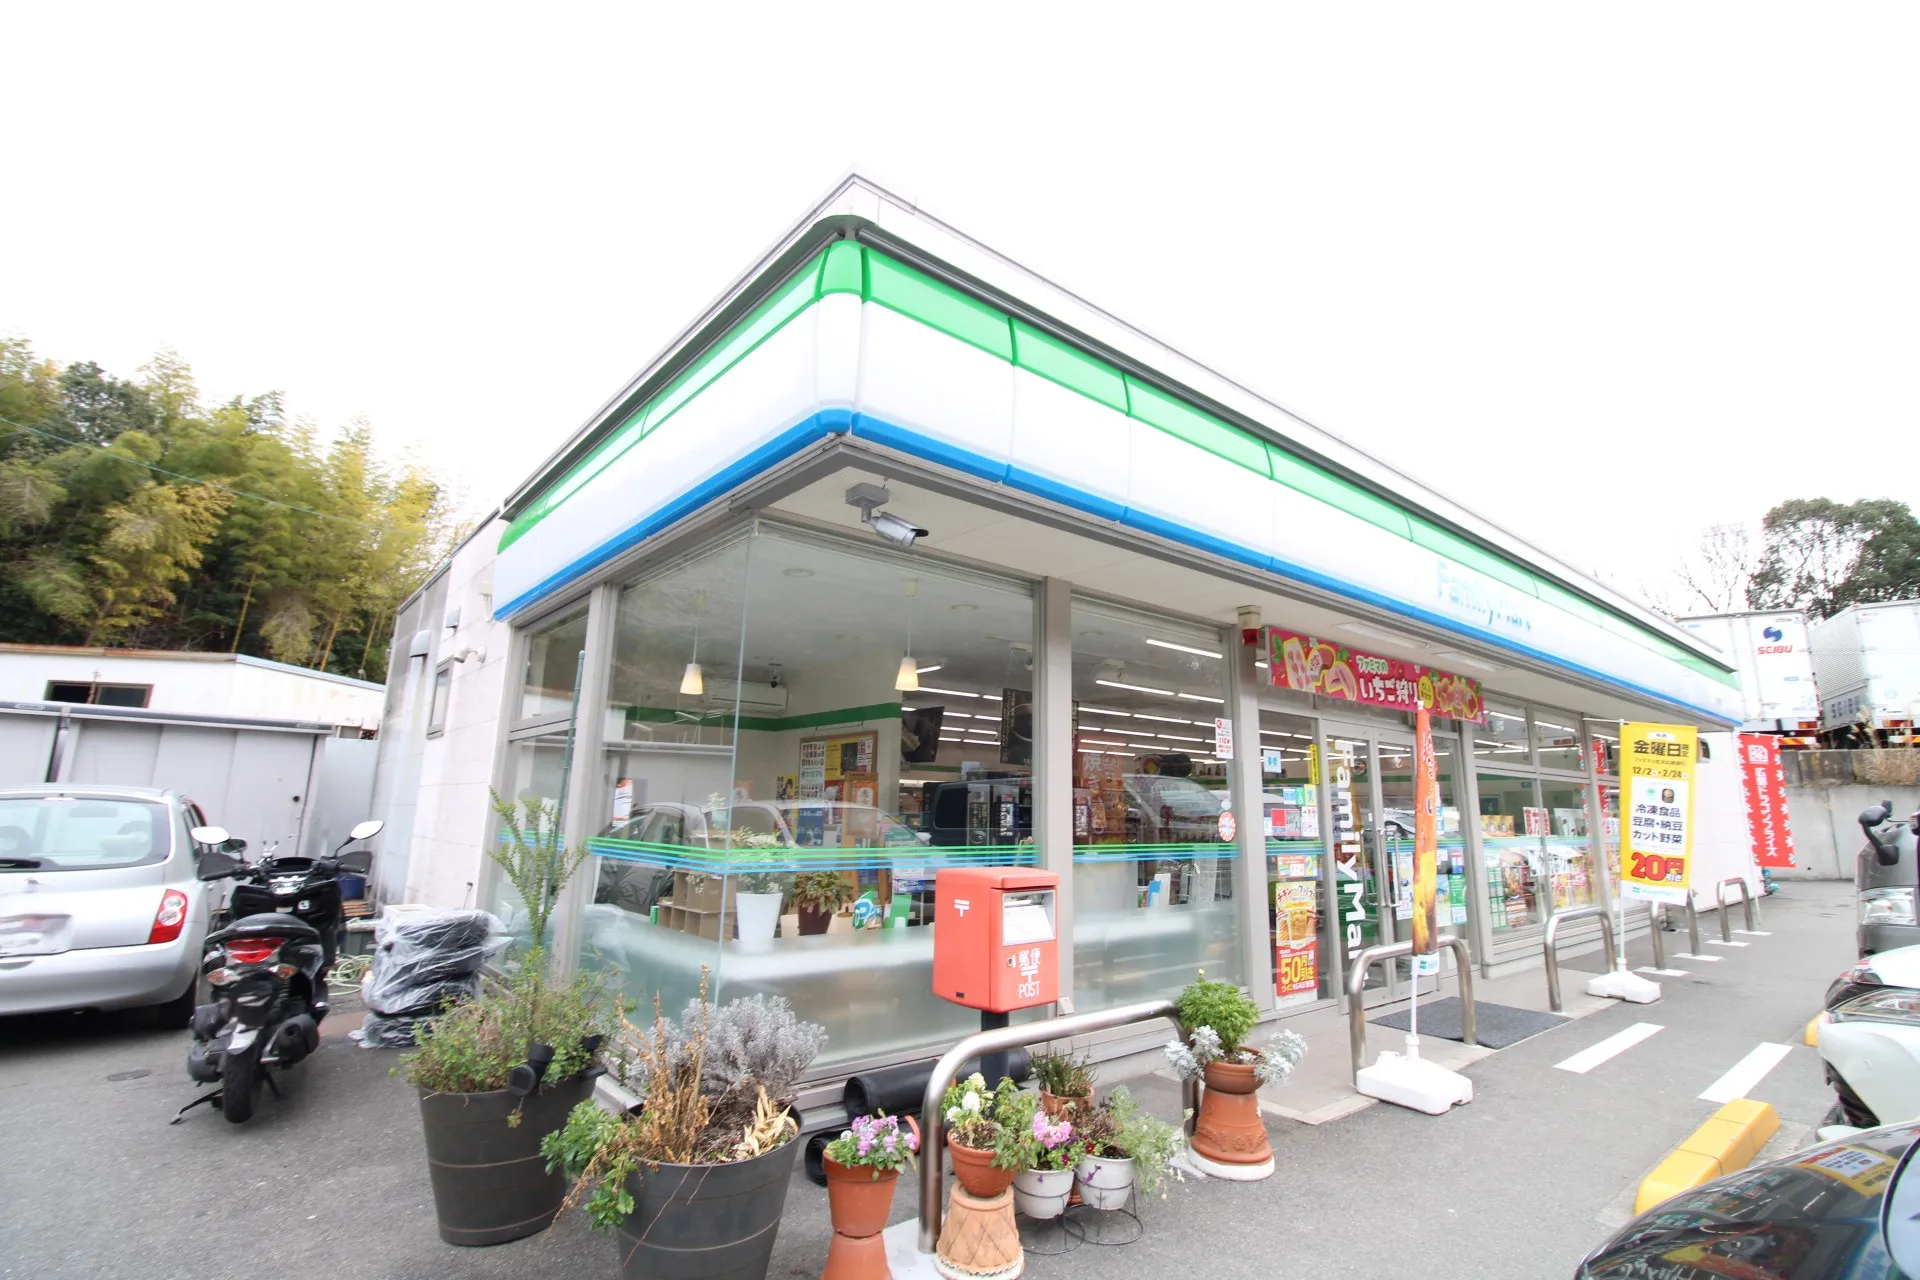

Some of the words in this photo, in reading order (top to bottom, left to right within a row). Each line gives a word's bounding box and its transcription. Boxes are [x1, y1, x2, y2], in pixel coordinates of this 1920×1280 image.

[1359, 676, 1420, 704] いちご狩り
[1633, 740, 1681, 757] 金曜日
[1635, 804, 1681, 818] 冷凍食品
[1632, 816, 1683, 832] 豆腐・納豆
[1633, 830, 1682, 844] カット野菜
[1334, 740, 1370, 988] FamilyMar
[1631, 852, 1685, 881] 20円
[1019, 947, 1041, 968] 郵便
[1018, 981, 1040, 999] POST
